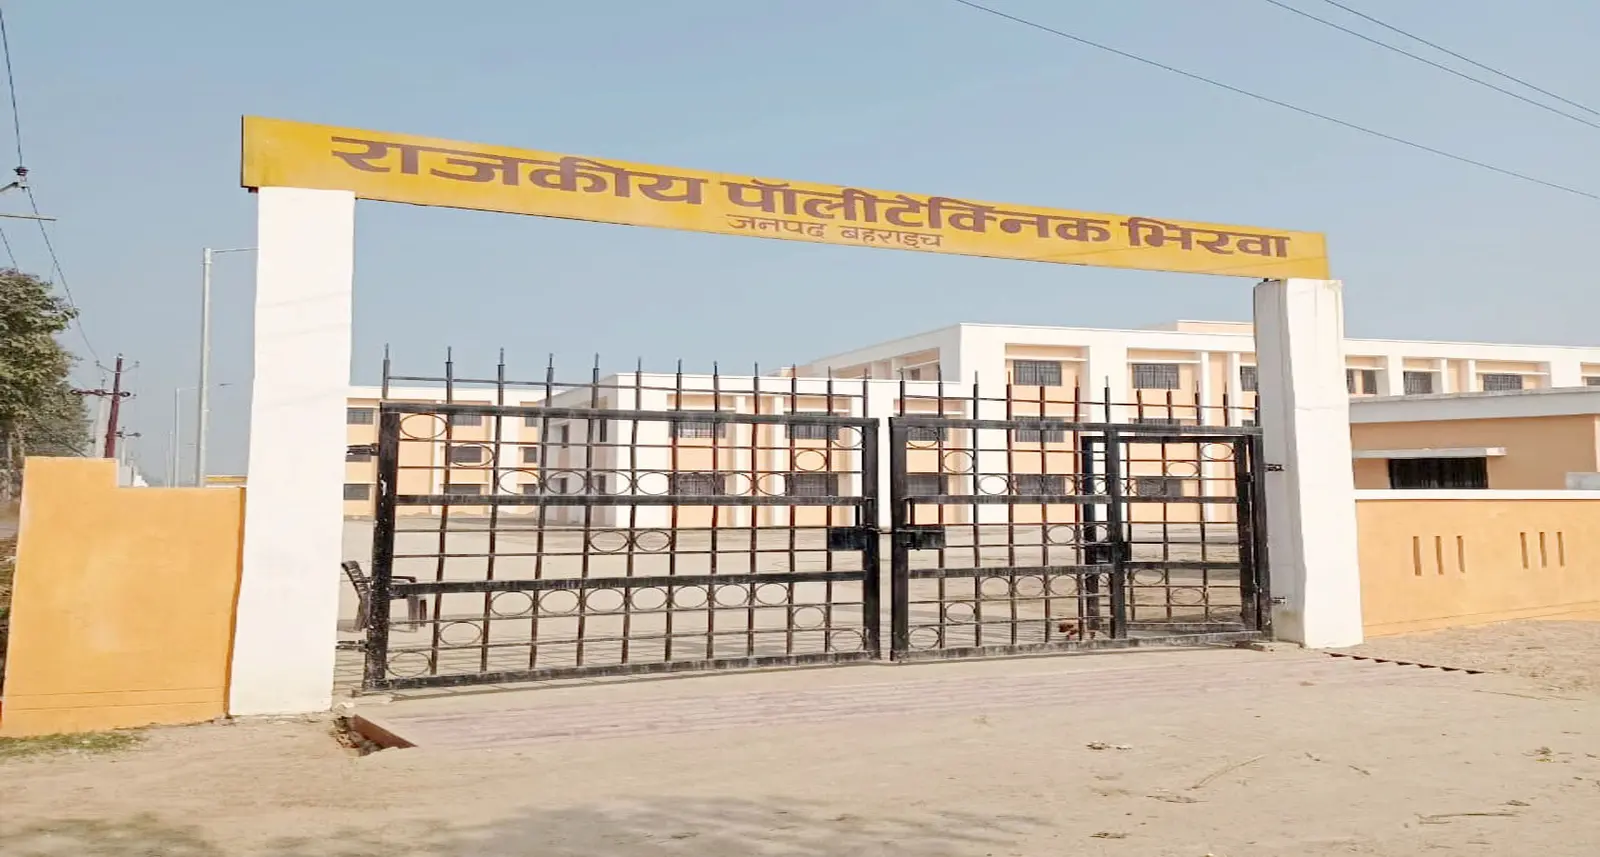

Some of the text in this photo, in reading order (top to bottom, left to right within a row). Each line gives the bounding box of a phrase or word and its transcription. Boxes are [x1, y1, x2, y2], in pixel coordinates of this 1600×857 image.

[331, 136, 708, 204] राजकीय
[721, 179, 1111, 243] पॉलीटेक्निक
[726, 213, 943, 248] जनपद बहराइच
